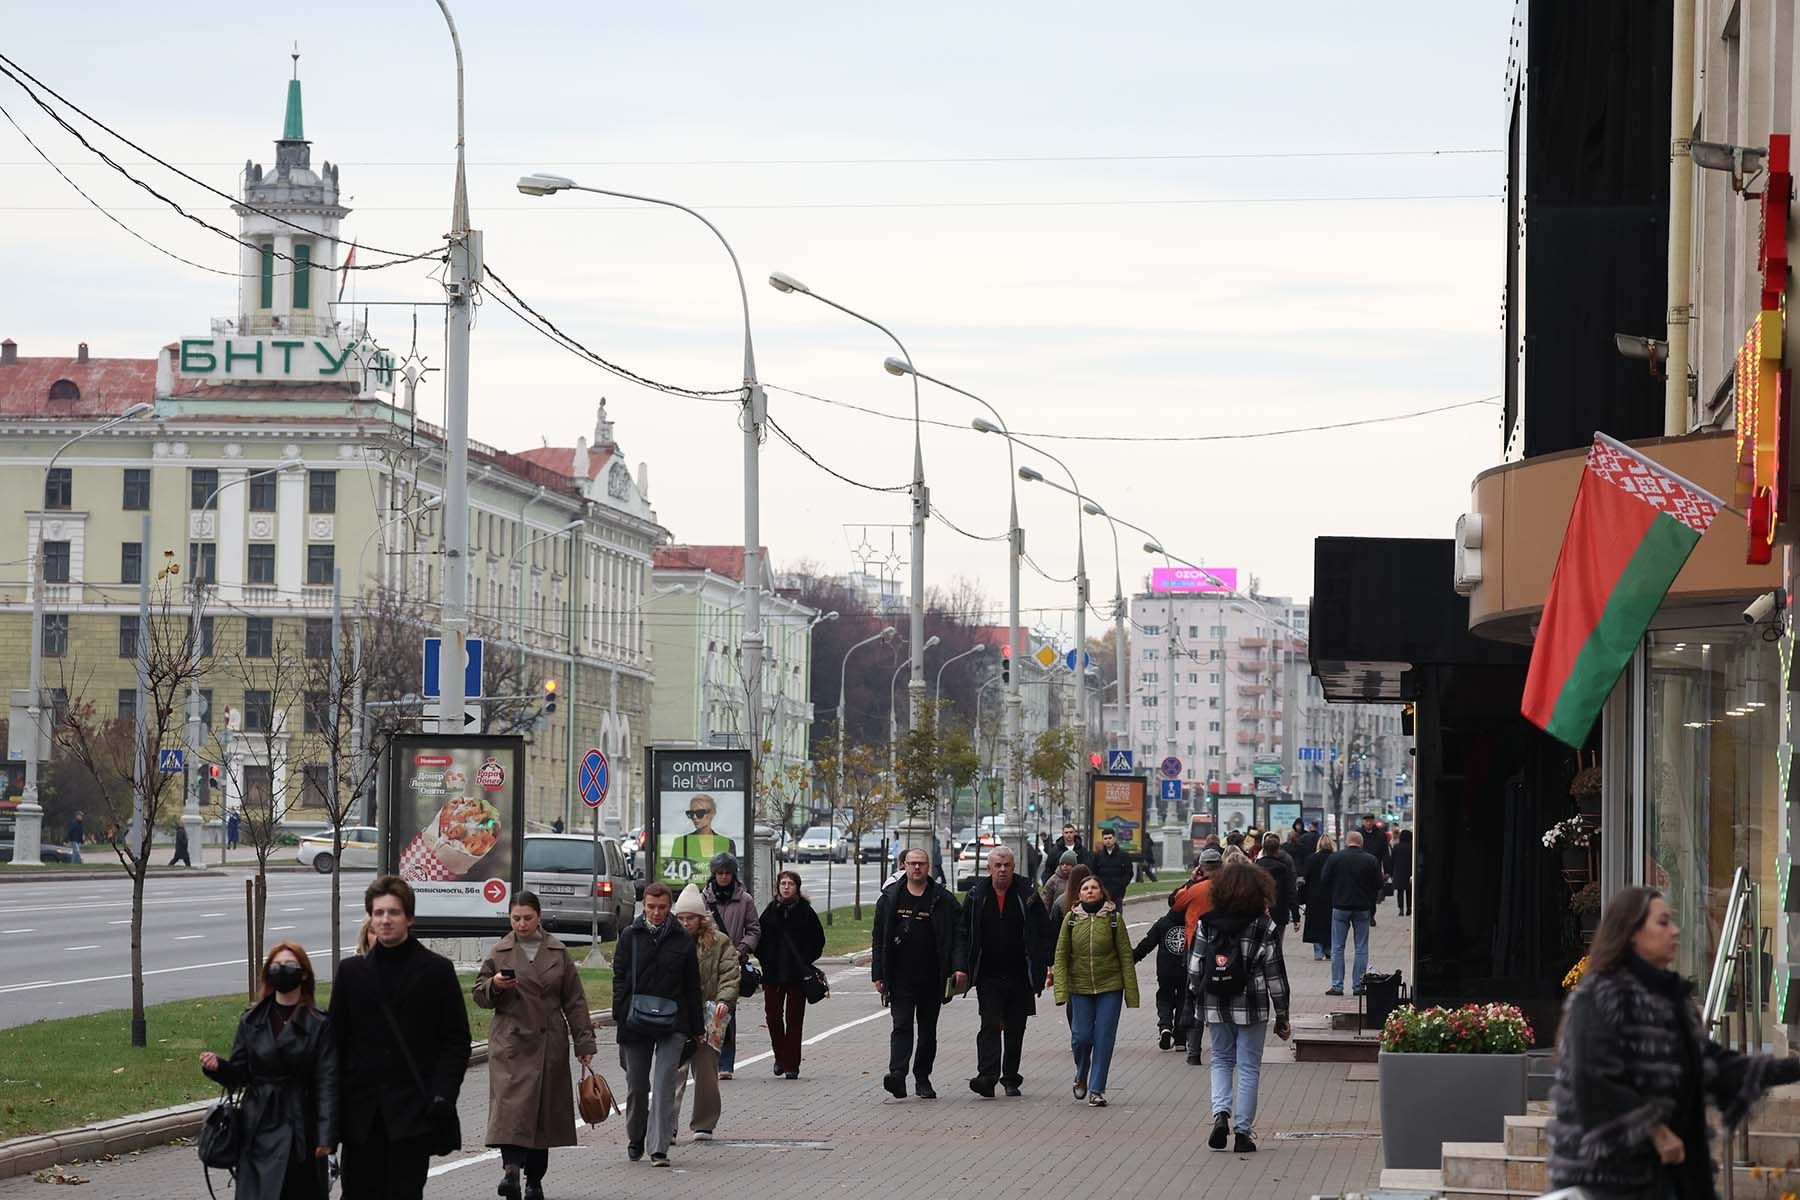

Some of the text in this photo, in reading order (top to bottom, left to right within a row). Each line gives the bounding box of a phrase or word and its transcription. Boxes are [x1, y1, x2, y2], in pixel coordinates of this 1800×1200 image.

[181, 340, 356, 374] БНТУ
[477, 769, 499, 778] Papa
[664, 861, 691, 880] 40
